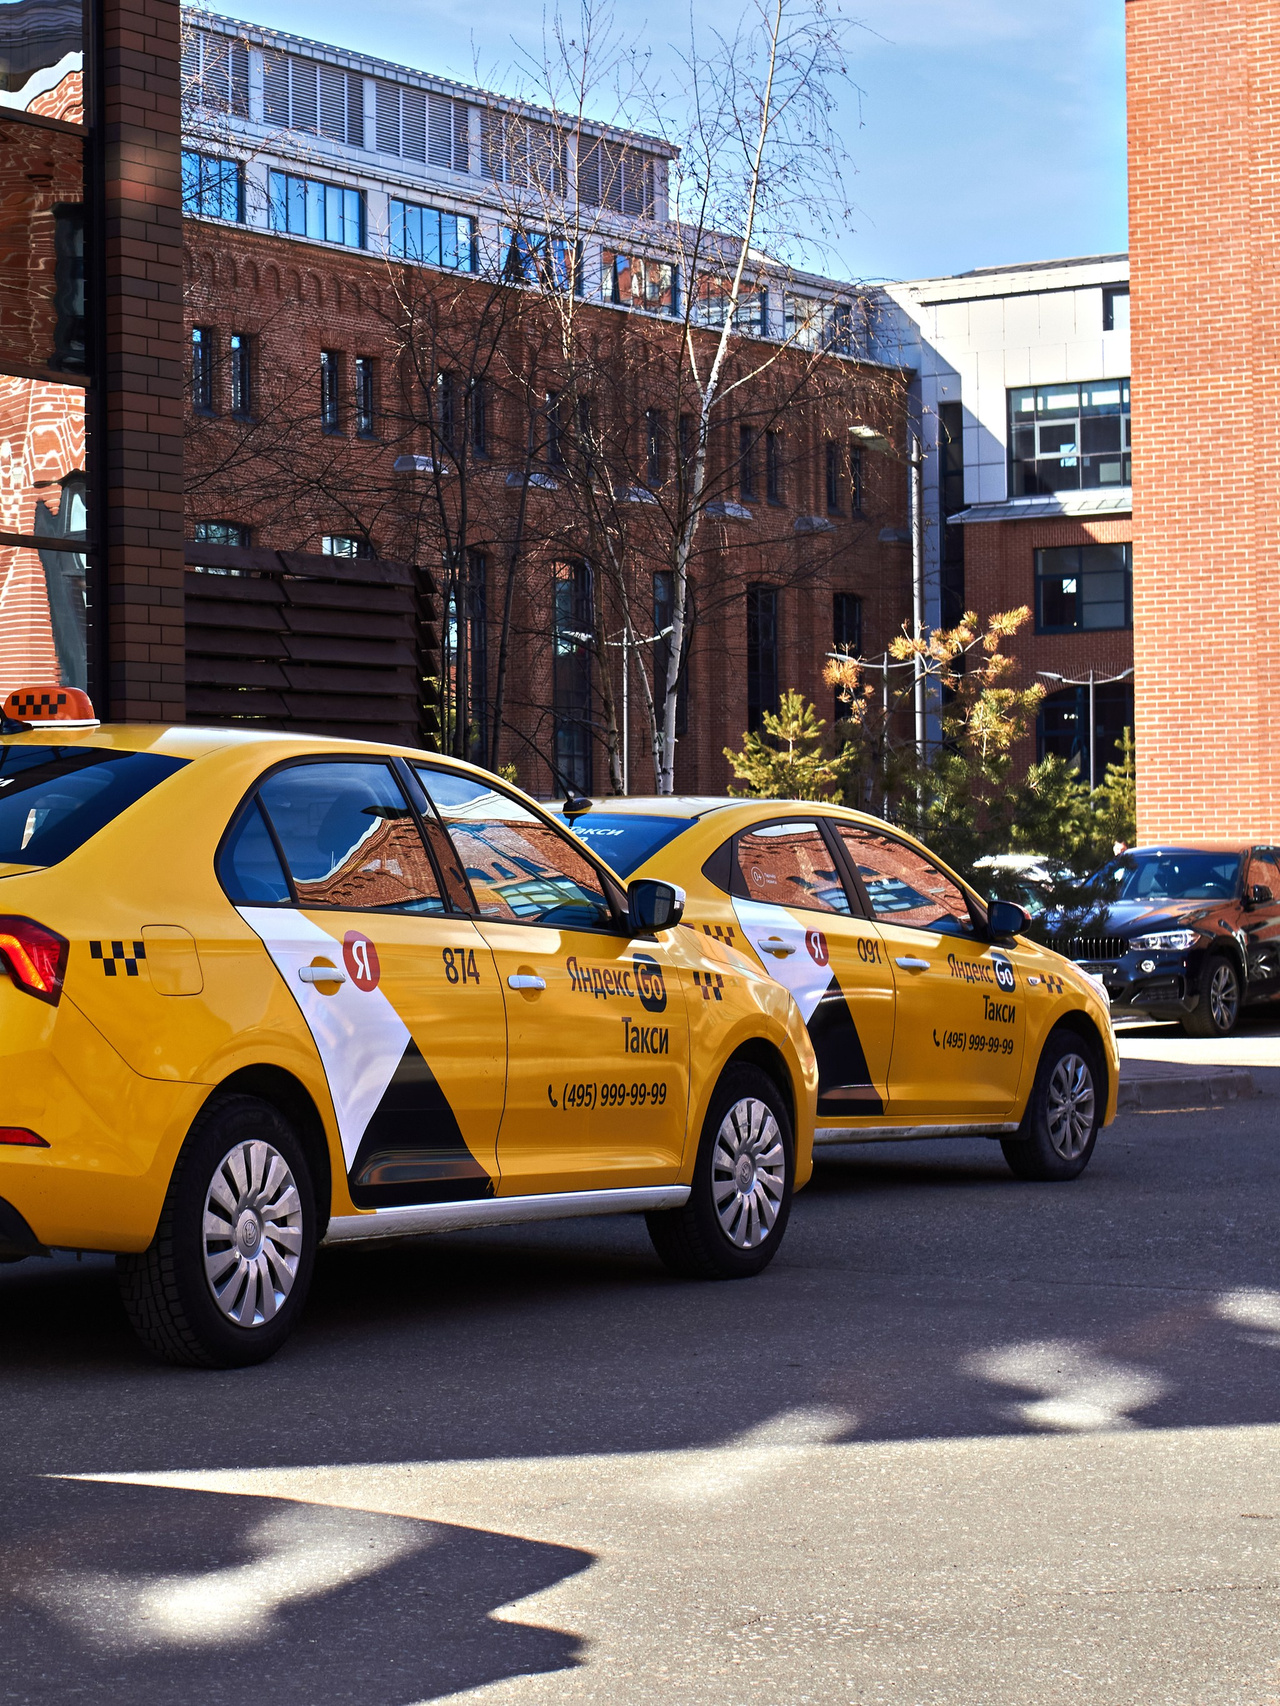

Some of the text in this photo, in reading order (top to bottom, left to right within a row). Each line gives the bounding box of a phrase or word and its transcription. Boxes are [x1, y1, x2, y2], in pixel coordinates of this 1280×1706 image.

[353, 940, 372, 981] Я
[810, 932, 824, 960] Я
[857, 938, 882, 964] 091
[442, 948, 480, 984] 874
[566, 956, 664, 1001] Яндекс Go
[947, 953, 1014, 987] Яндекс Go
[983, 995, 1016, 1024] Такси
[621, 1016, 669, 1054] Такси
[942, 1030, 1014, 1055] (495) 999-99-99
[562, 1082, 667, 1111] (495) 999-99-99
